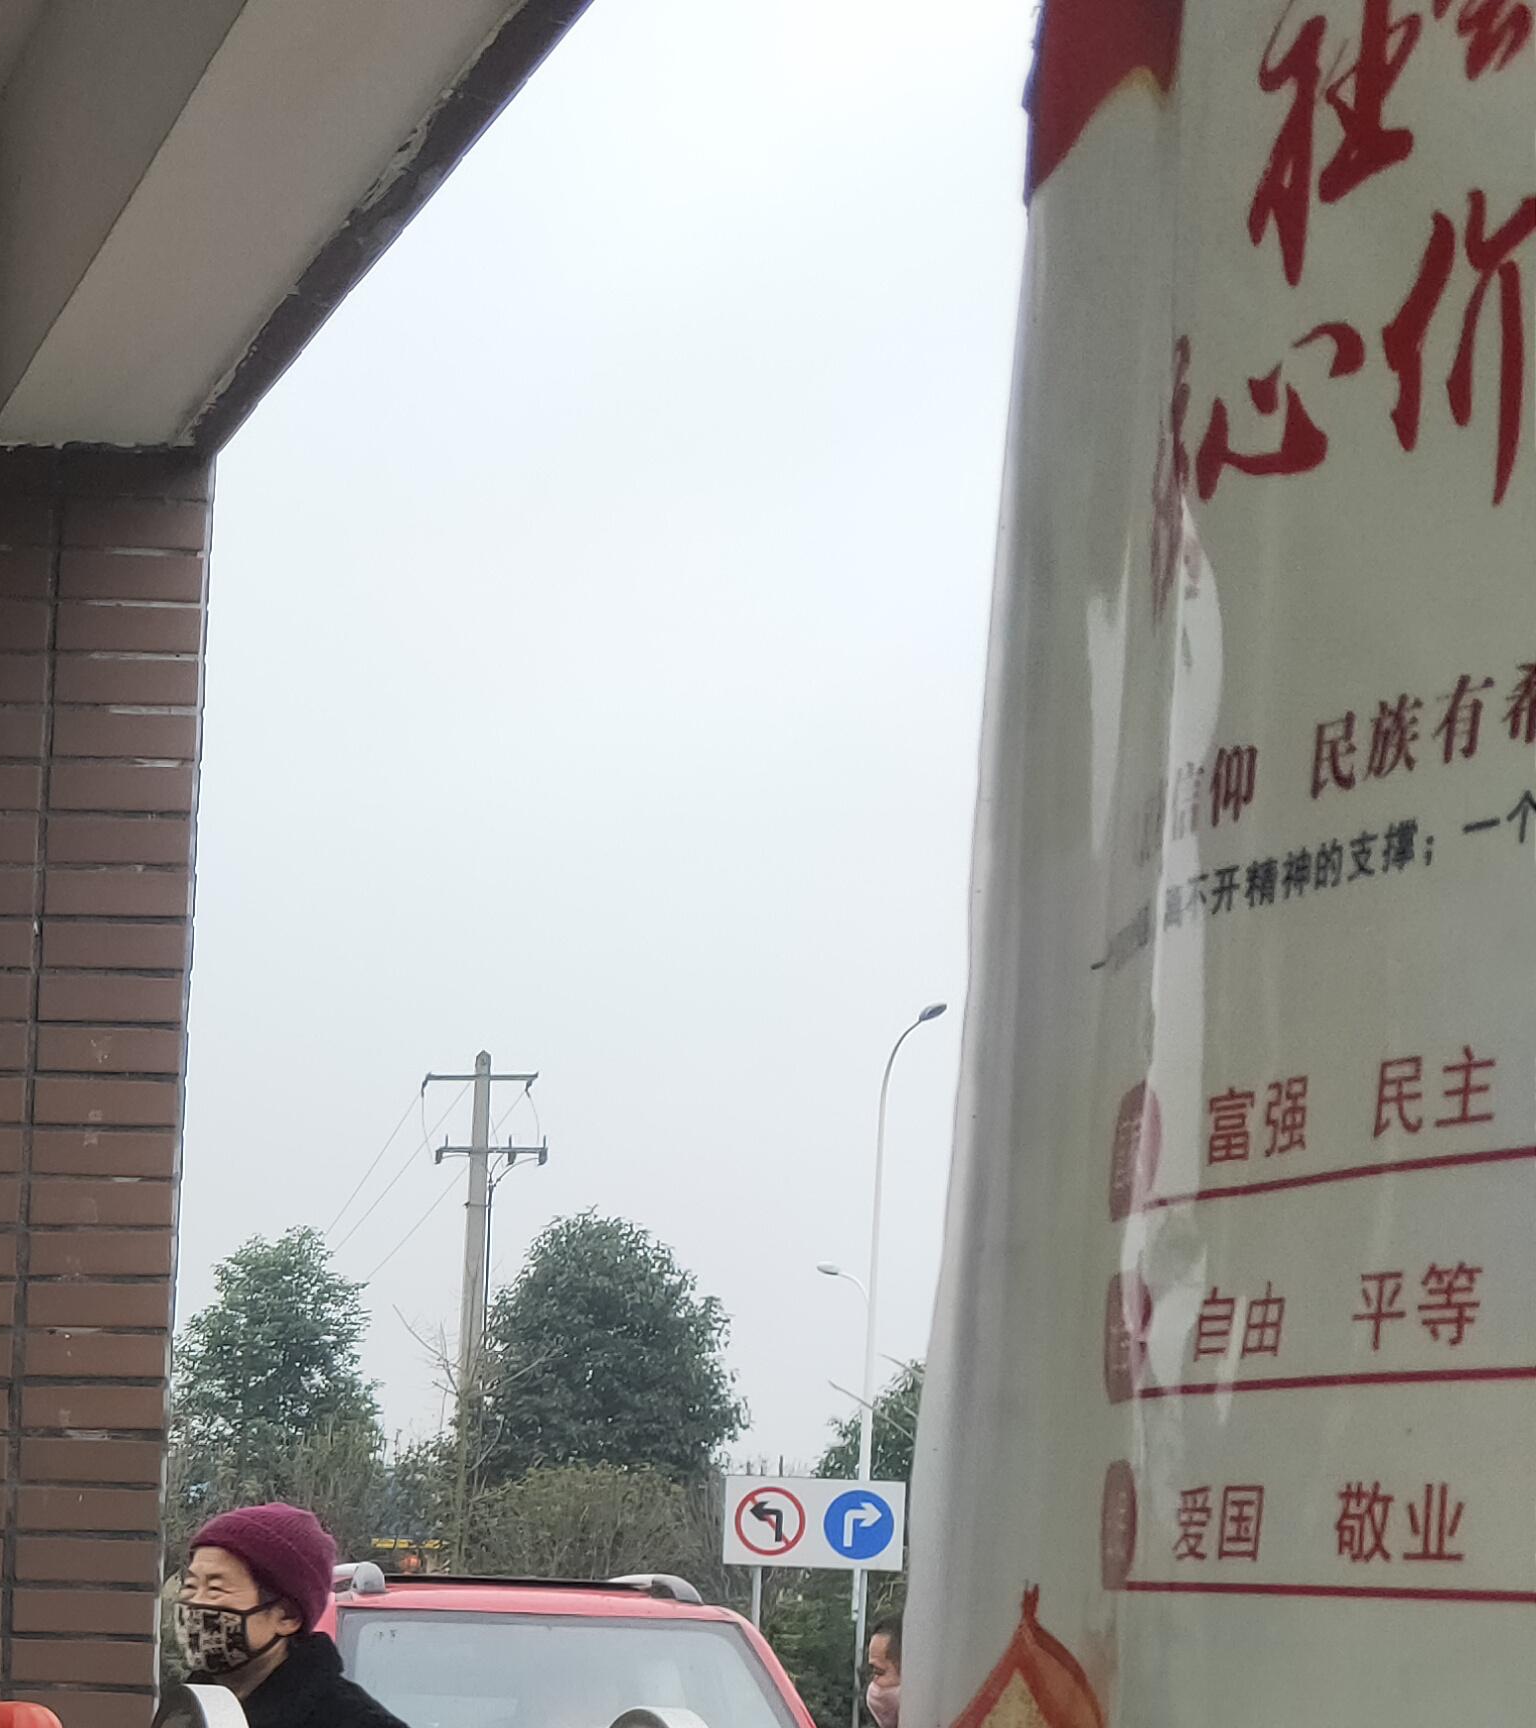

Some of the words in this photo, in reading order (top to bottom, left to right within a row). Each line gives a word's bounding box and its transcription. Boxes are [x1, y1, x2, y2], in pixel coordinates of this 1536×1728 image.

[1206, 1074, 1309, 1166] 富强
[1373, 1045, 1496, 1139] 民主
[1193, 1280, 1286, 1363] 自由
[1351, 1261, 1483, 1352] 平等
[1172, 1484, 1265, 1563] 爱国
[1334, 1481, 1466, 1564] 敬业
